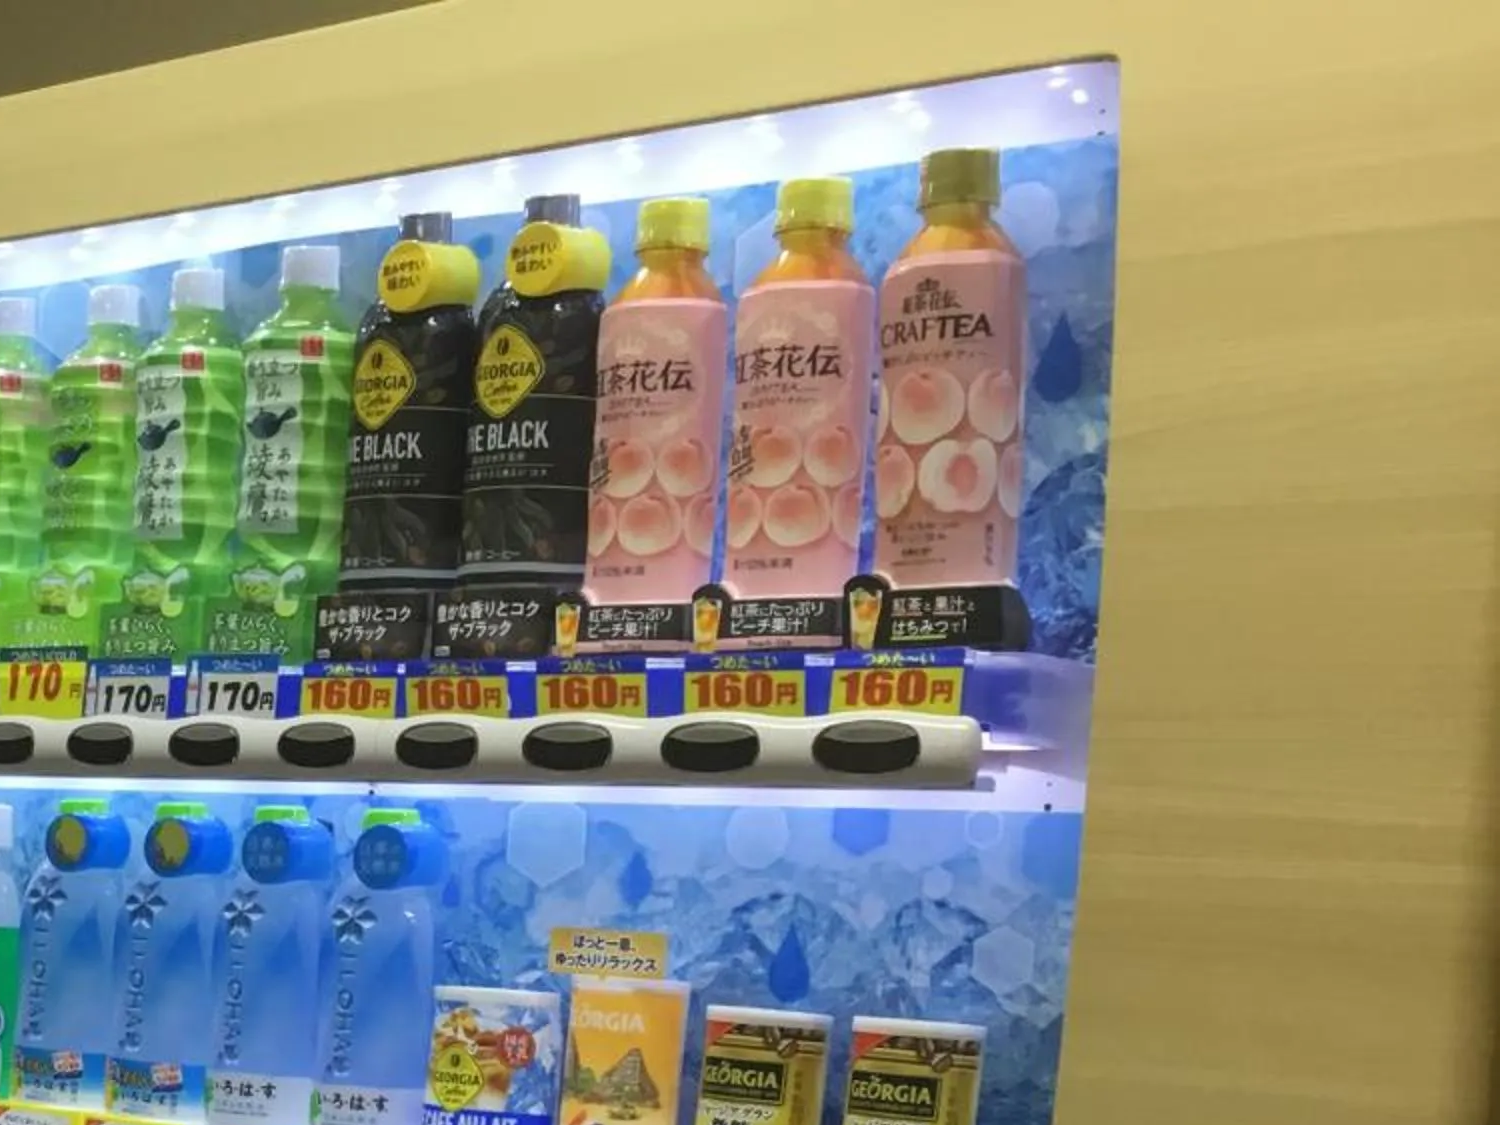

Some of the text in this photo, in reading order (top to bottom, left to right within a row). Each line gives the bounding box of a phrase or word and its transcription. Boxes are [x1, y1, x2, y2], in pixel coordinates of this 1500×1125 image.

[881, 313, 994, 348] CRAFTEA
[363, 432, 422, 461] BLACK
[487, 420, 549, 450] BLACK
[438, 602, 539, 623] 豊かな香りとコク
[8, 664, 81, 701] 170円
[207, 681, 274, 712] 170円
[308, 679, 390, 711] 160円
[412, 679, 500, 711] 160円
[542, 675, 641, 709] 160円
[691, 672, 797, 708] 160円
[841, 668, 953, 706] 160円
[104, 685, 166, 713] 170円
[706, 1059, 779, 1089] GEORGIA
[851, 1075, 932, 1105] GEORGIA
